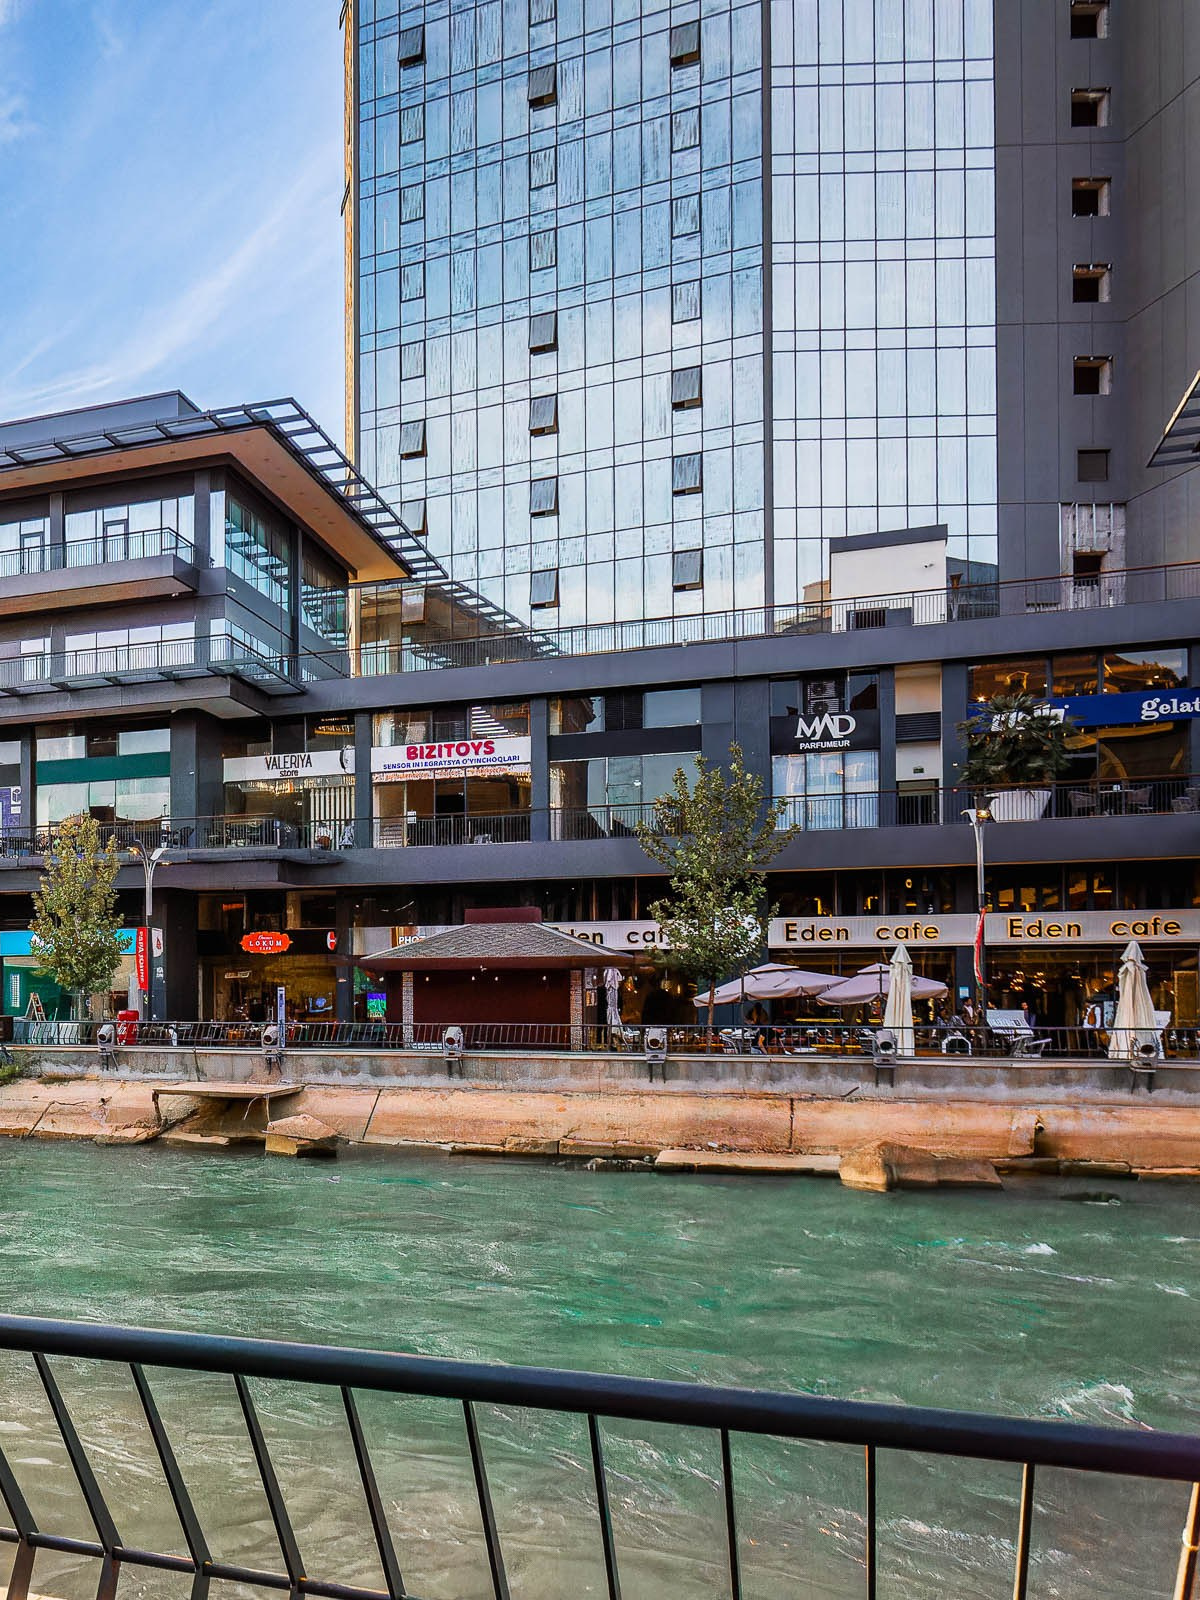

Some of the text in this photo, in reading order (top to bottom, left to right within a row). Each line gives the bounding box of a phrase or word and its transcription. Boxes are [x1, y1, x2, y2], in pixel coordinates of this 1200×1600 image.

[794, 713, 856, 740] MAD
[406, 740, 495, 760] BIZITOYS
[800, 740, 850, 750] PARFUMEUR
[265, 754, 313, 770] VALERIYA
[279, 769, 299, 777] store
[785, 921, 939, 941] Eden cafe
[1009, 917, 1181, 938] Eden cafe
